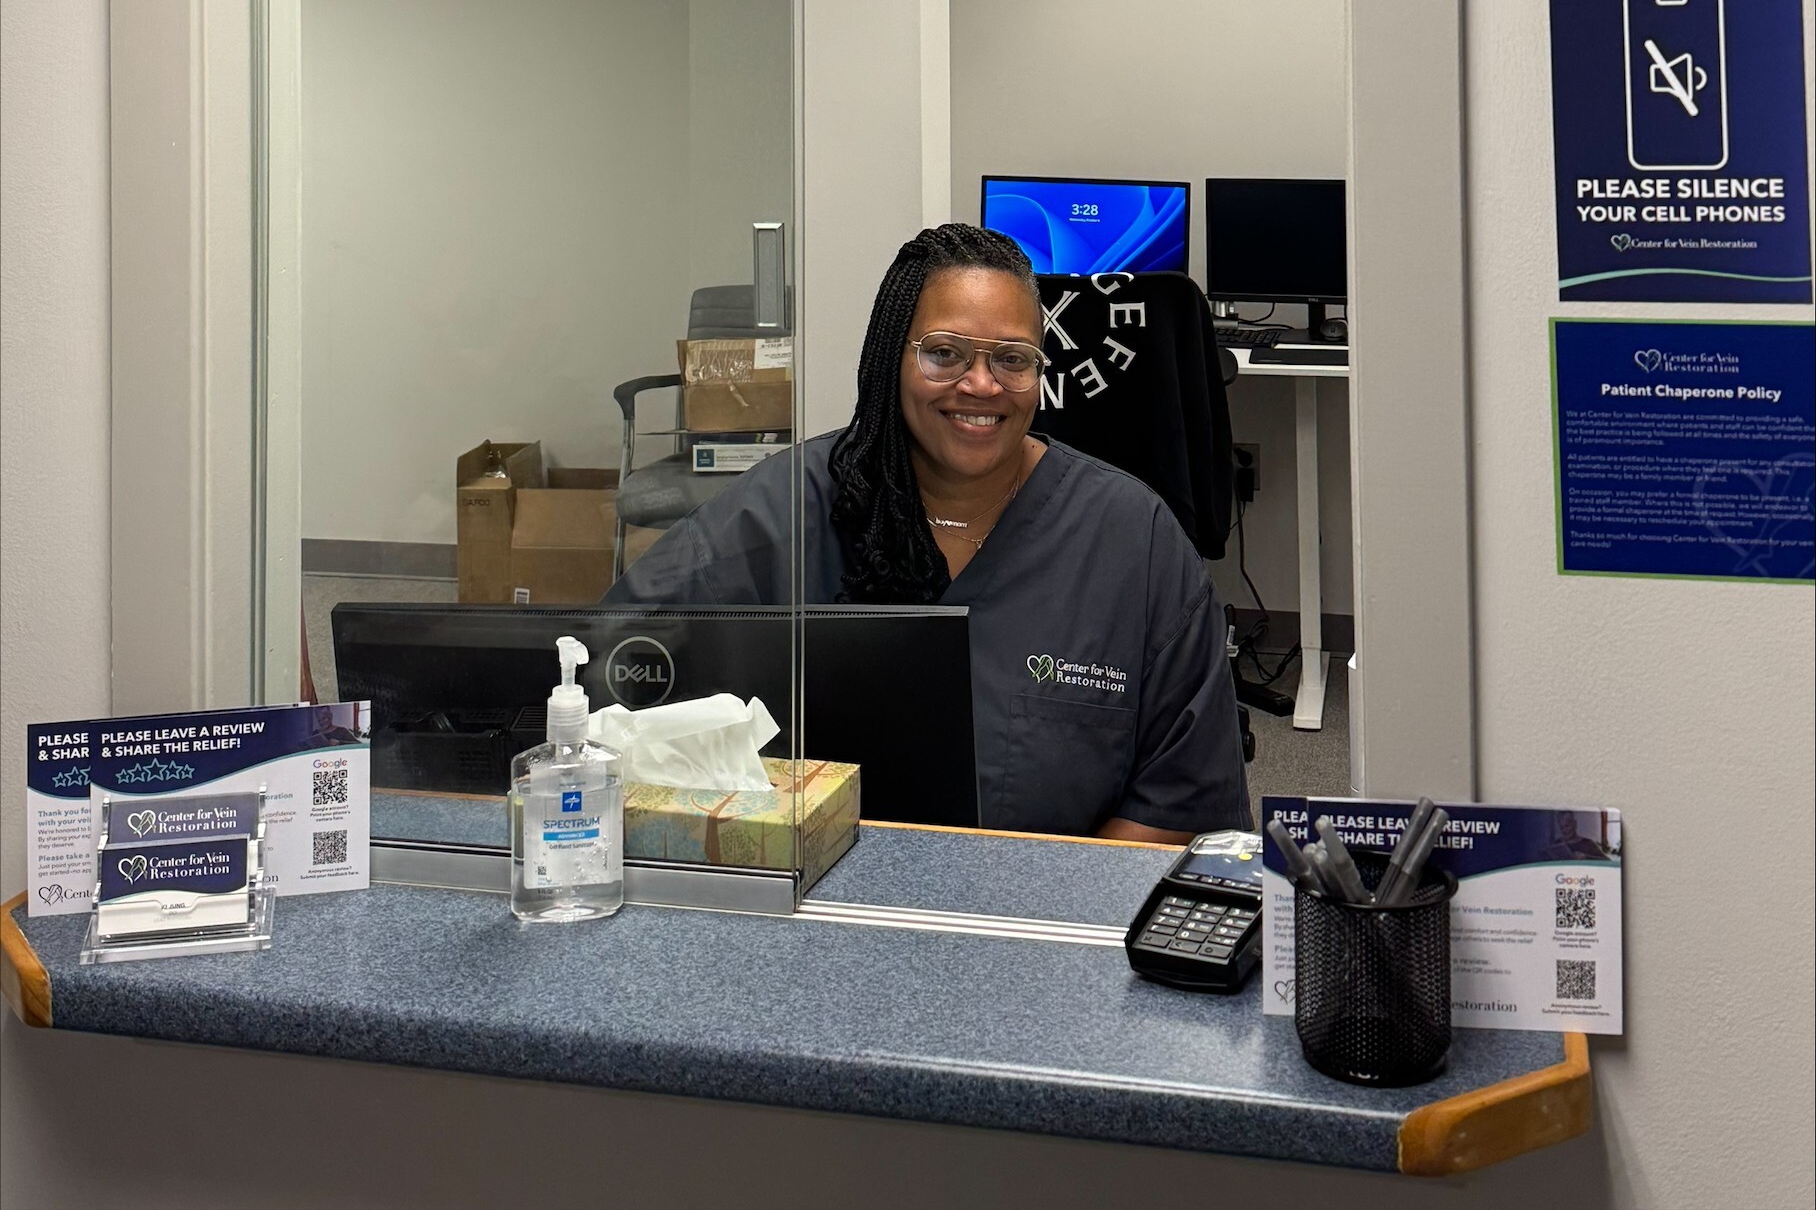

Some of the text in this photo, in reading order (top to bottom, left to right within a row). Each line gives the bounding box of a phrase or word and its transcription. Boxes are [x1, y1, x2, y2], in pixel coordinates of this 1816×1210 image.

[1576, 178, 1785, 199] PLEASE SILENCE
[1071, 203, 1099, 216] 3:28
[1576, 205, 1786, 222] YOUR CELL PHONES
[1631, 238, 1758, 249] Center for Vein Restoration
[1662, 352, 1739, 364] Center for Vein
[1664, 362, 1740, 373] Restoration
[1601, 383, 1782, 403] Patient Chaperone Policy
[615, 664, 668, 683] DELL
[1056, 659, 1127, 680] Center for Vein
[1056, 671, 1125, 692] Restoration
[38, 733, 89, 747] PLEASE
[101, 722, 265, 744] PLEASE LEAVE A REVIEW
[38, 747, 90, 761] & SHAR
[101, 738, 241, 758] & SHARE THE RELIEF!
[313, 758, 348, 769] Google
[38, 809, 62, 817] Thank
[158, 807, 237, 823] Center for Vein
[1274, 810, 1308, 823] PLEA
[58, 819, 76, 827] your
[159, 819, 237, 833] Restoration
[543, 817, 600, 829] SPECTRUM
[1378, 817, 1409, 831] LEA
[1443, 820, 1500, 834] REVIEW
[1337, 831, 1385, 845] SHARE
[1434, 836, 1474, 850] LIEF!
[149, 852, 230, 868] Center for Vein
[150, 864, 230, 880] Restoration
[1555, 873, 1595, 887] Google
[1274, 894, 1295, 902] Than
[1461, 906, 1533, 916] Vein Restoration
[1452, 999, 1517, 1012] estoration
